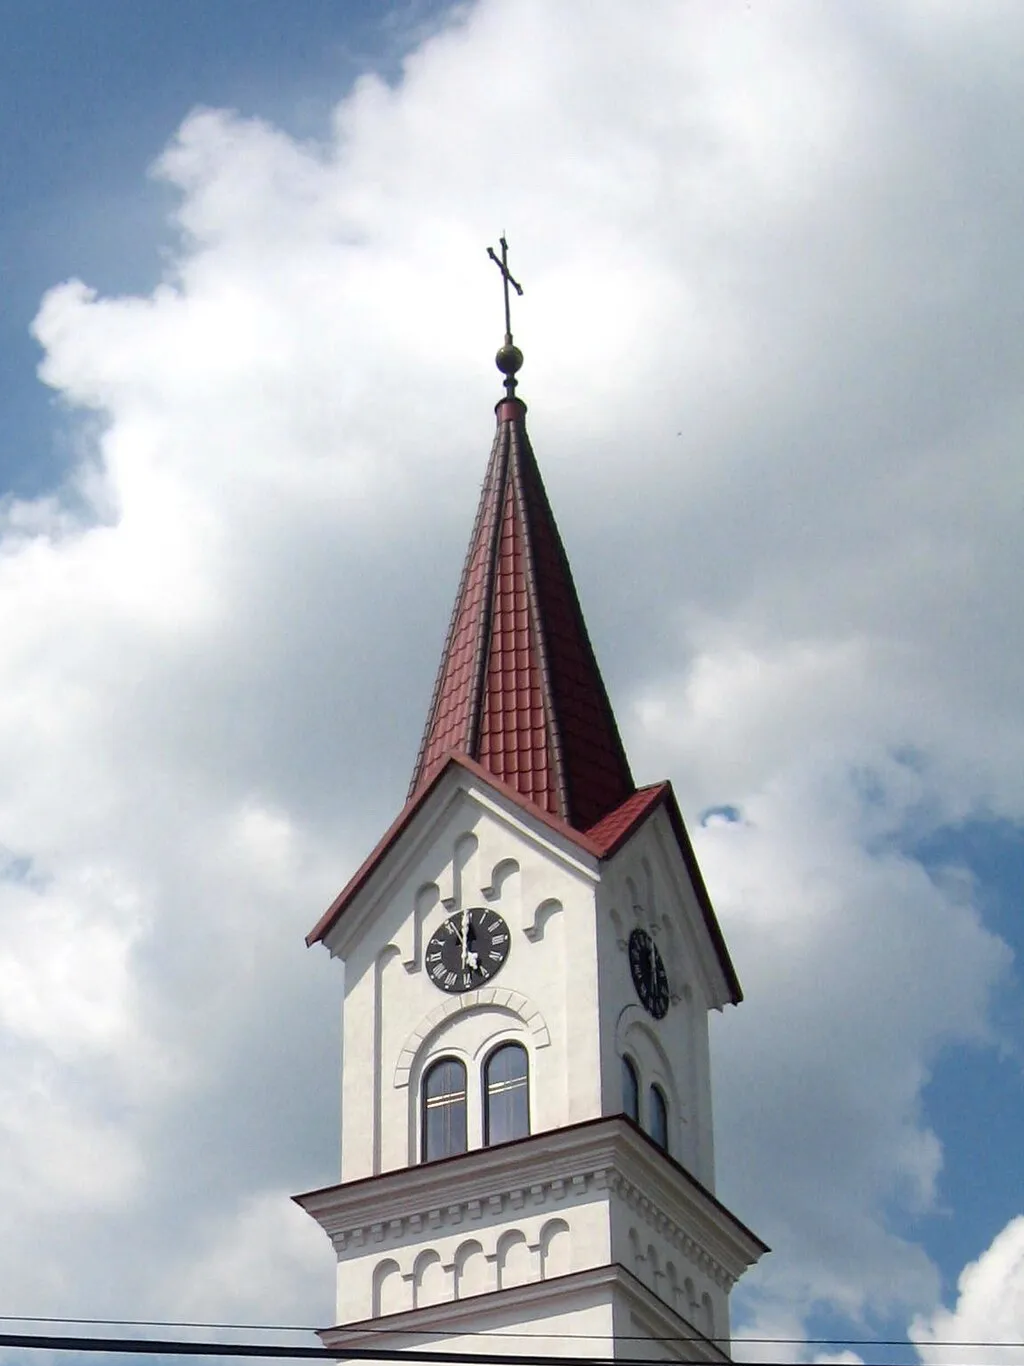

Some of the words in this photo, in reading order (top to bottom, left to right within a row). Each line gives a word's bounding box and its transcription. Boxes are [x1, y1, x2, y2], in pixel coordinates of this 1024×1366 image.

[479, 913, 486, 925] I
[491, 934, 504, 945] III
[430, 952, 442, 962] IX
